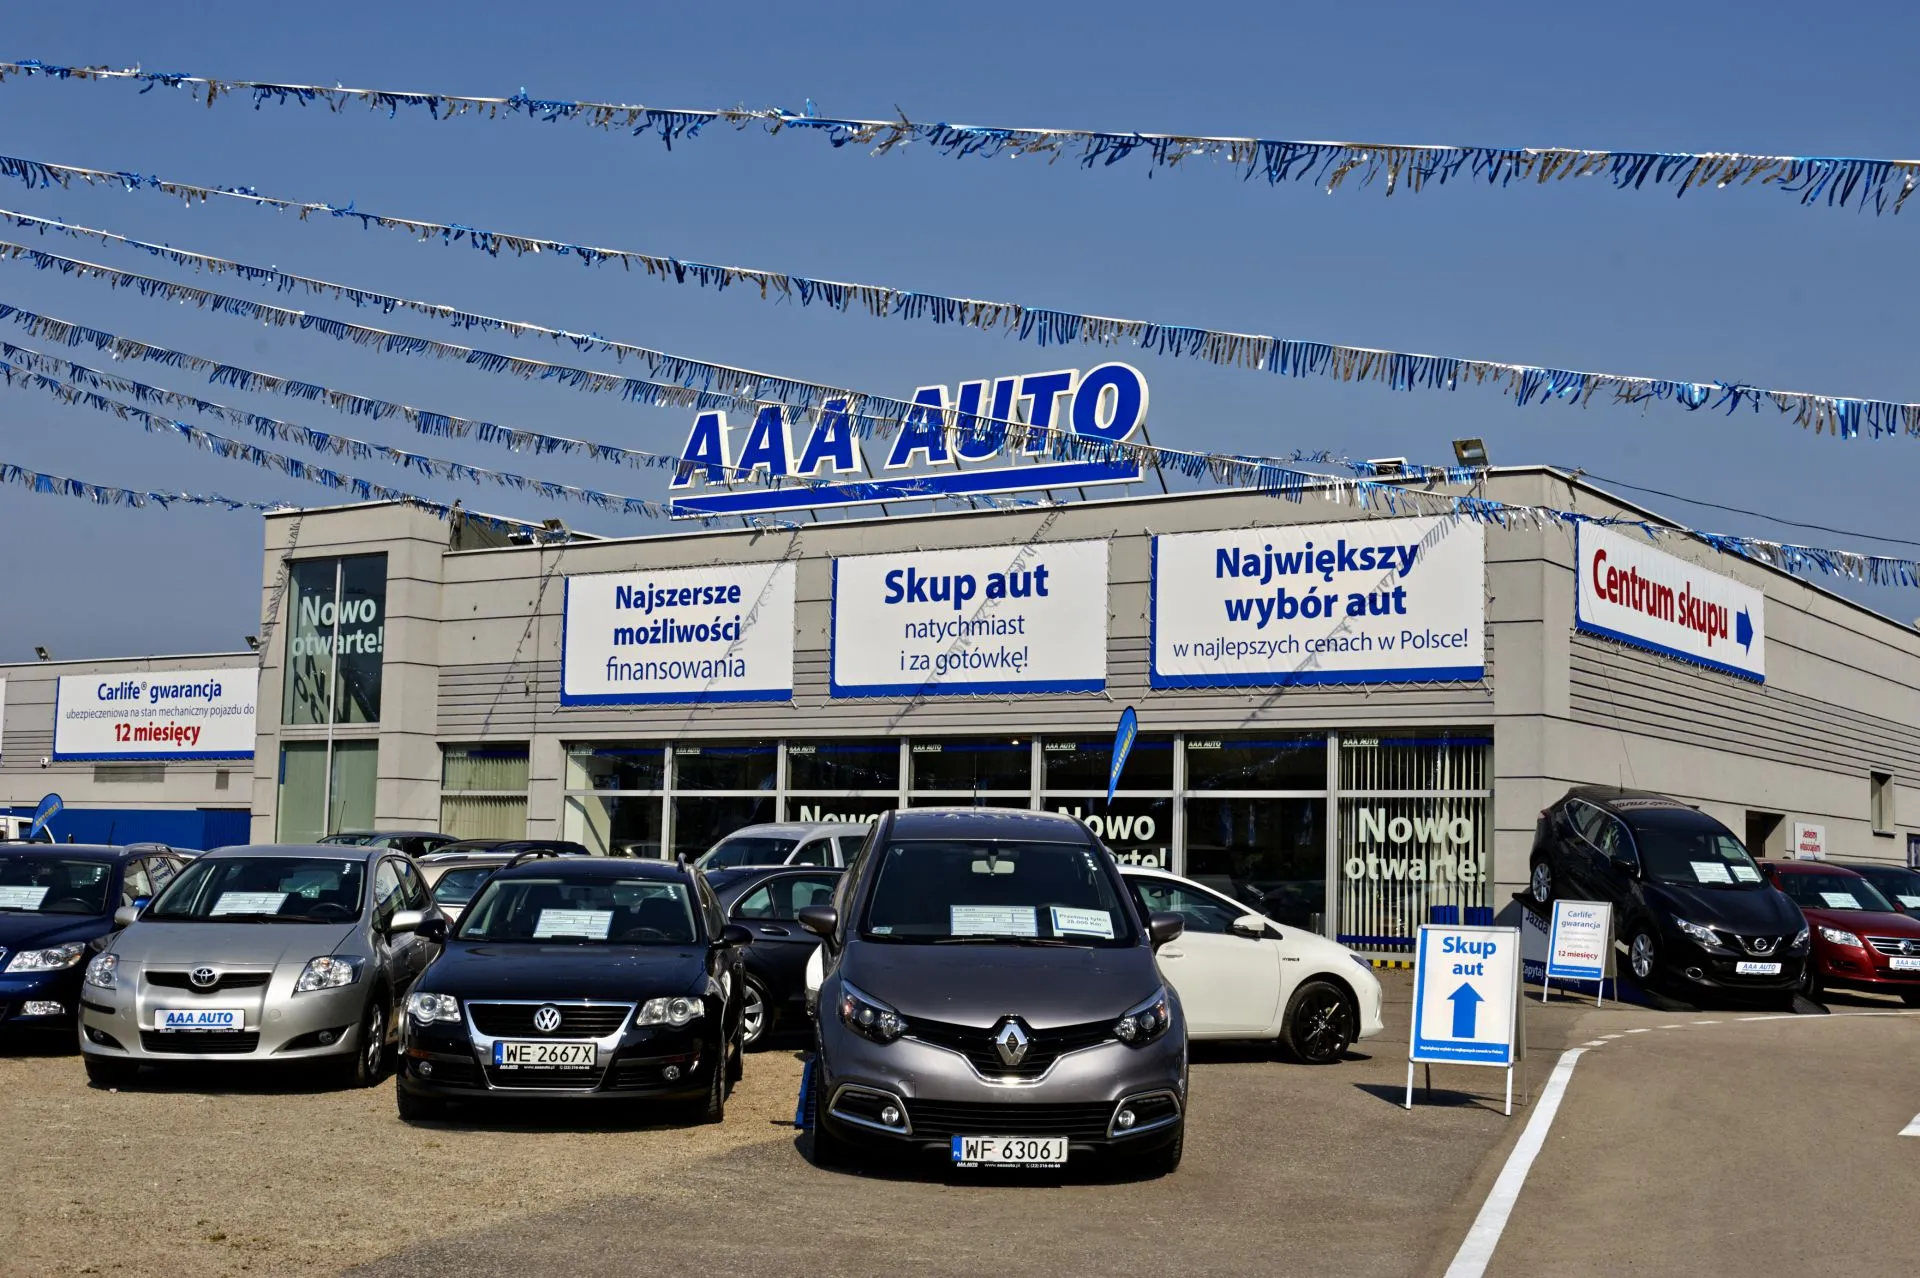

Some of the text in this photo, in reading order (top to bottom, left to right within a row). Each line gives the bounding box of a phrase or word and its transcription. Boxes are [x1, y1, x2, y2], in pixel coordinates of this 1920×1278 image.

[669, 361, 1150, 490] AAA AUTO
[1216, 539, 1419, 584] Największy
[615, 584, 741, 613] Najszersze
[884, 564, 1049, 611] Skup aut
[1592, 548, 1729, 646] Centrum skupu
[302, 595, 377, 627] Nowo
[1225, 583, 1407, 629] wybór aut
[291, 626, 384, 657] otwarte!
[613, 614, 741, 645] możliwości
[904, 614, 1025, 642] natychmiast
[1173, 628, 1469, 660] w najlepszych cenach w Polsce!
[607, 653, 746, 682] finansowania
[900, 645, 1029, 675] i za gotówkę!
[149, 678, 223, 704] gwarancja
[66, 703, 255, 721] ubezpieczeniowa na stan mechaniczny pojazdu do
[114, 720, 201, 747] 12 miesięcy
[1358, 807, 1473, 844] Nowo
[1345, 852, 1487, 882] otwarte!
[1442, 936, 1497, 959] Skup
[1452, 962, 1484, 976] aut
[166, 1012, 234, 1023] AAA AUTO
[506, 1045, 592, 1063] WE 2667X
[965, 1140, 1063, 1160] WF 6306J
